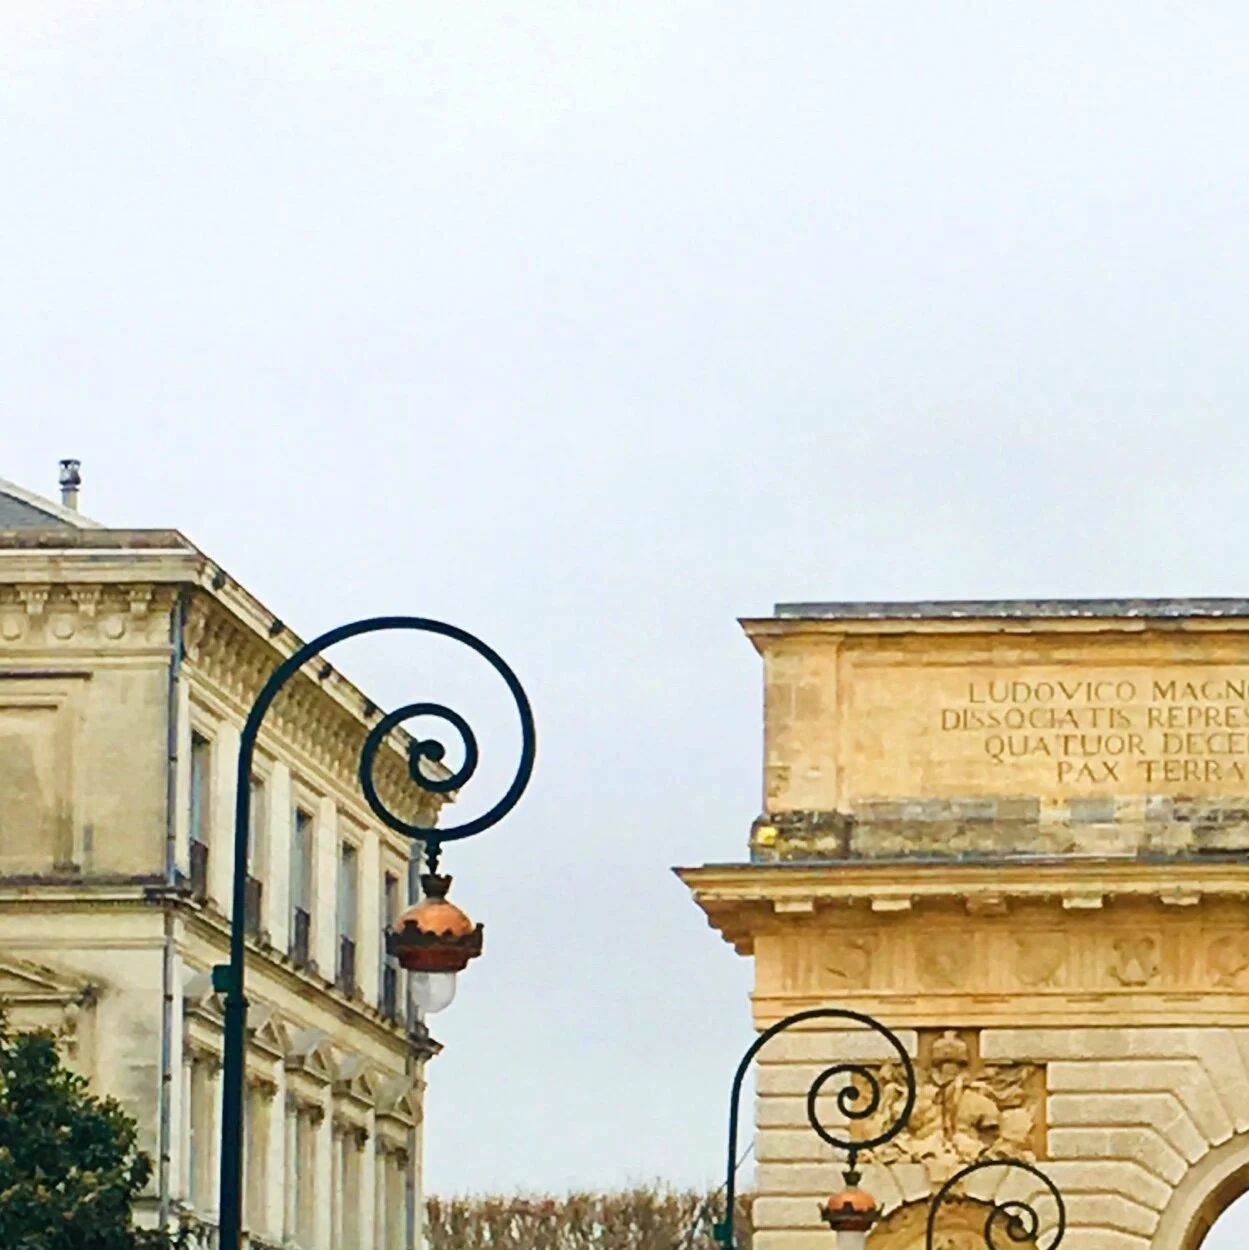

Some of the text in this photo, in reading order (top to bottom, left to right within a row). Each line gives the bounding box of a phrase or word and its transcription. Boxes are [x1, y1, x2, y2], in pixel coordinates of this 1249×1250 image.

[968, 680, 1137, 704] LUDOVICO
[940, 706, 1132, 731] DISSOCIATIS
[984, 733, 1146, 764] QUATUOR
[1056, 760, 1120, 784] PAX
[1136, 759, 1245, 783] TERRA
